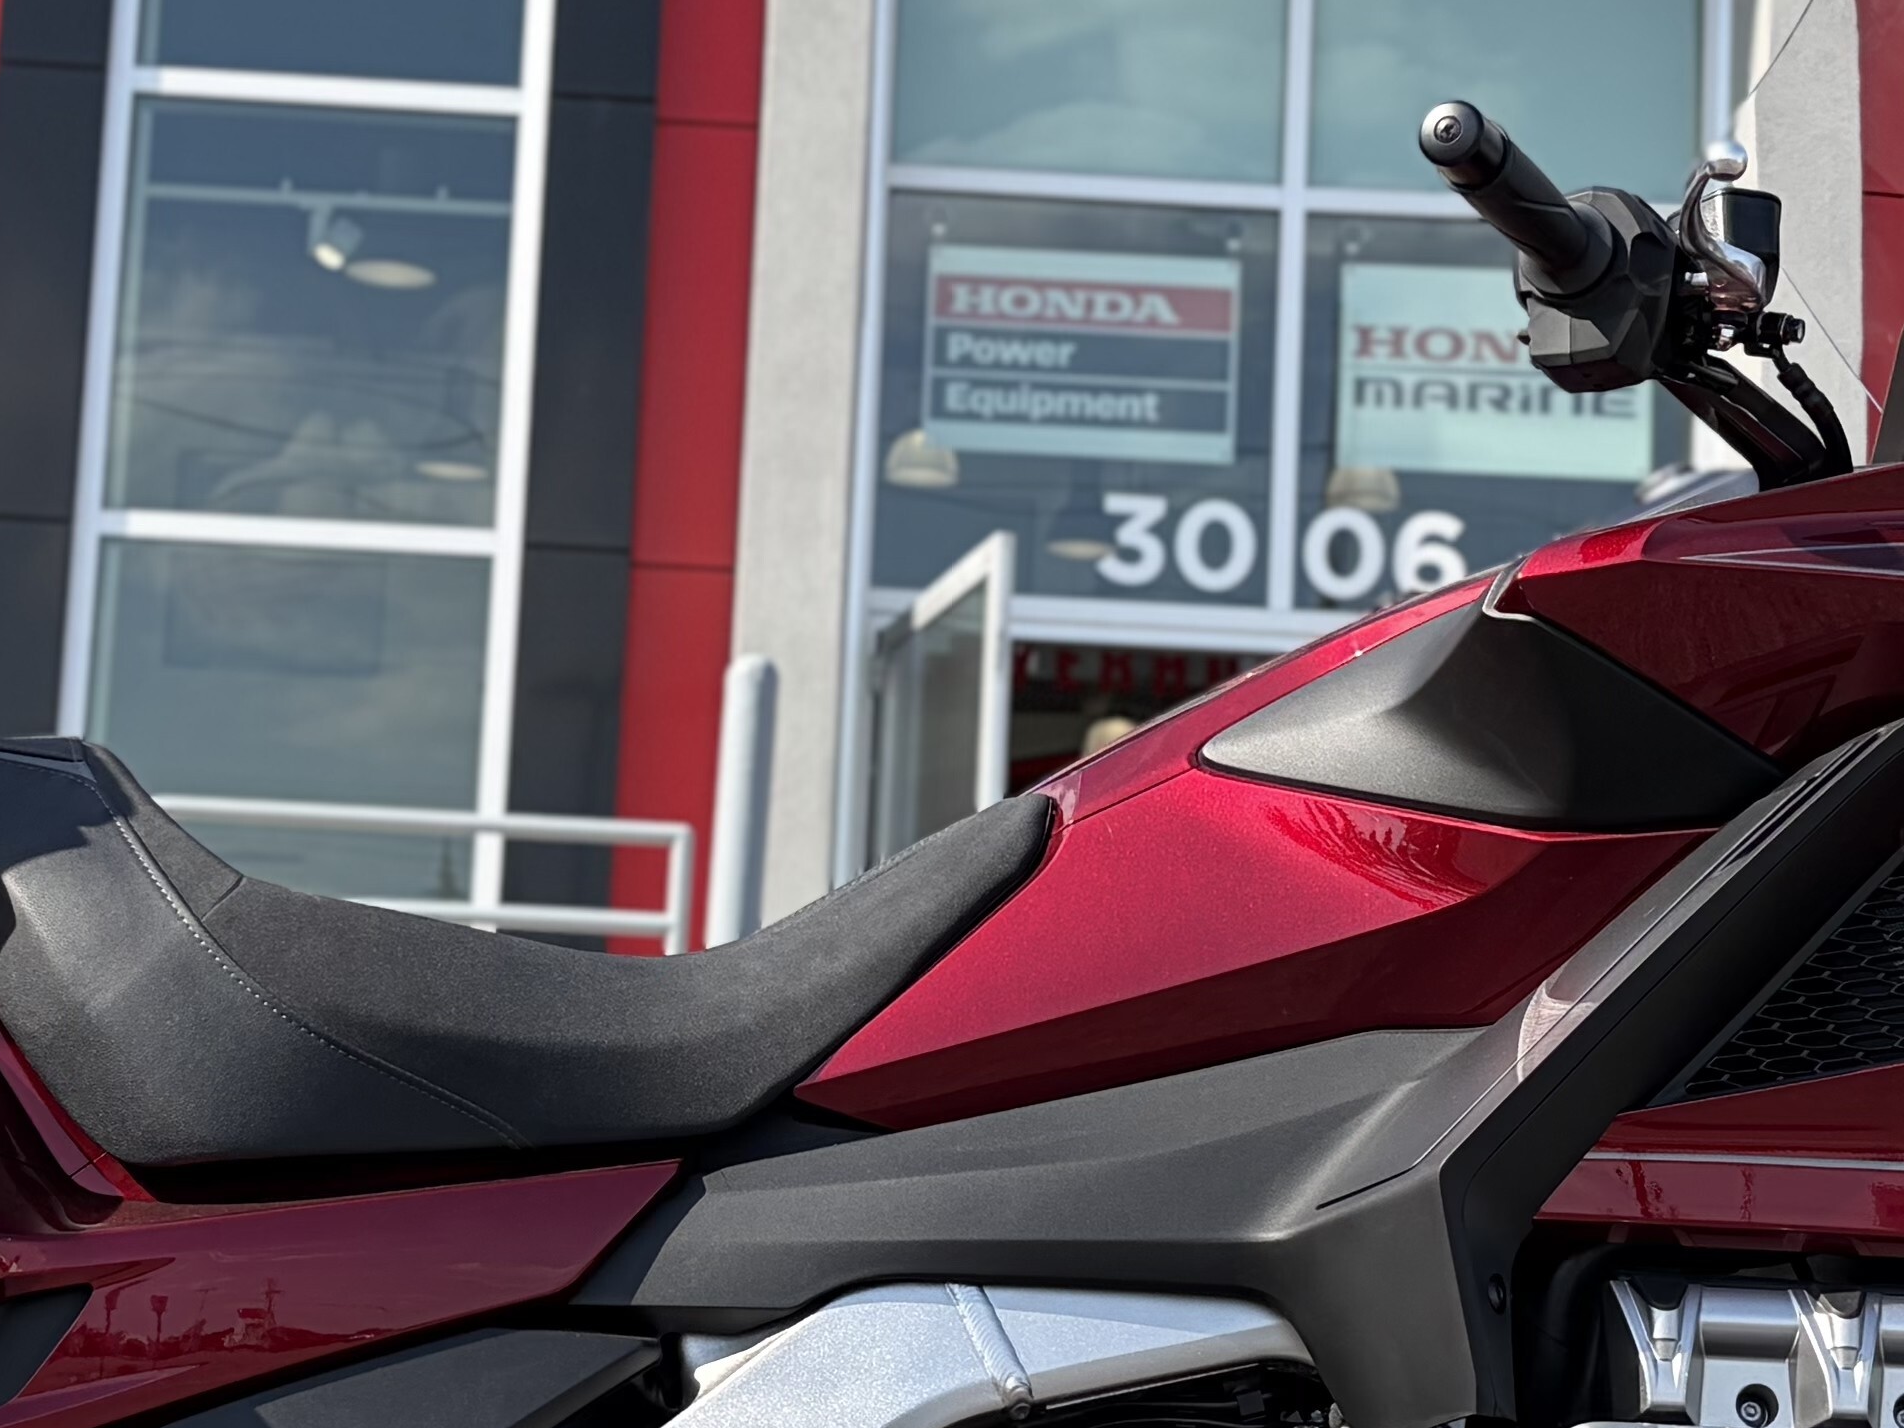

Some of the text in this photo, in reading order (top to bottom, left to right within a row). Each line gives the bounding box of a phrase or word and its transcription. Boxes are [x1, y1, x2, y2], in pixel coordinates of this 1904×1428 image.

[951, 283, 1179, 324] HONDA
[946, 332, 1077, 368] Power
[1352, 324, 1519, 364] HON
[946, 381, 1160, 422] Equipment
